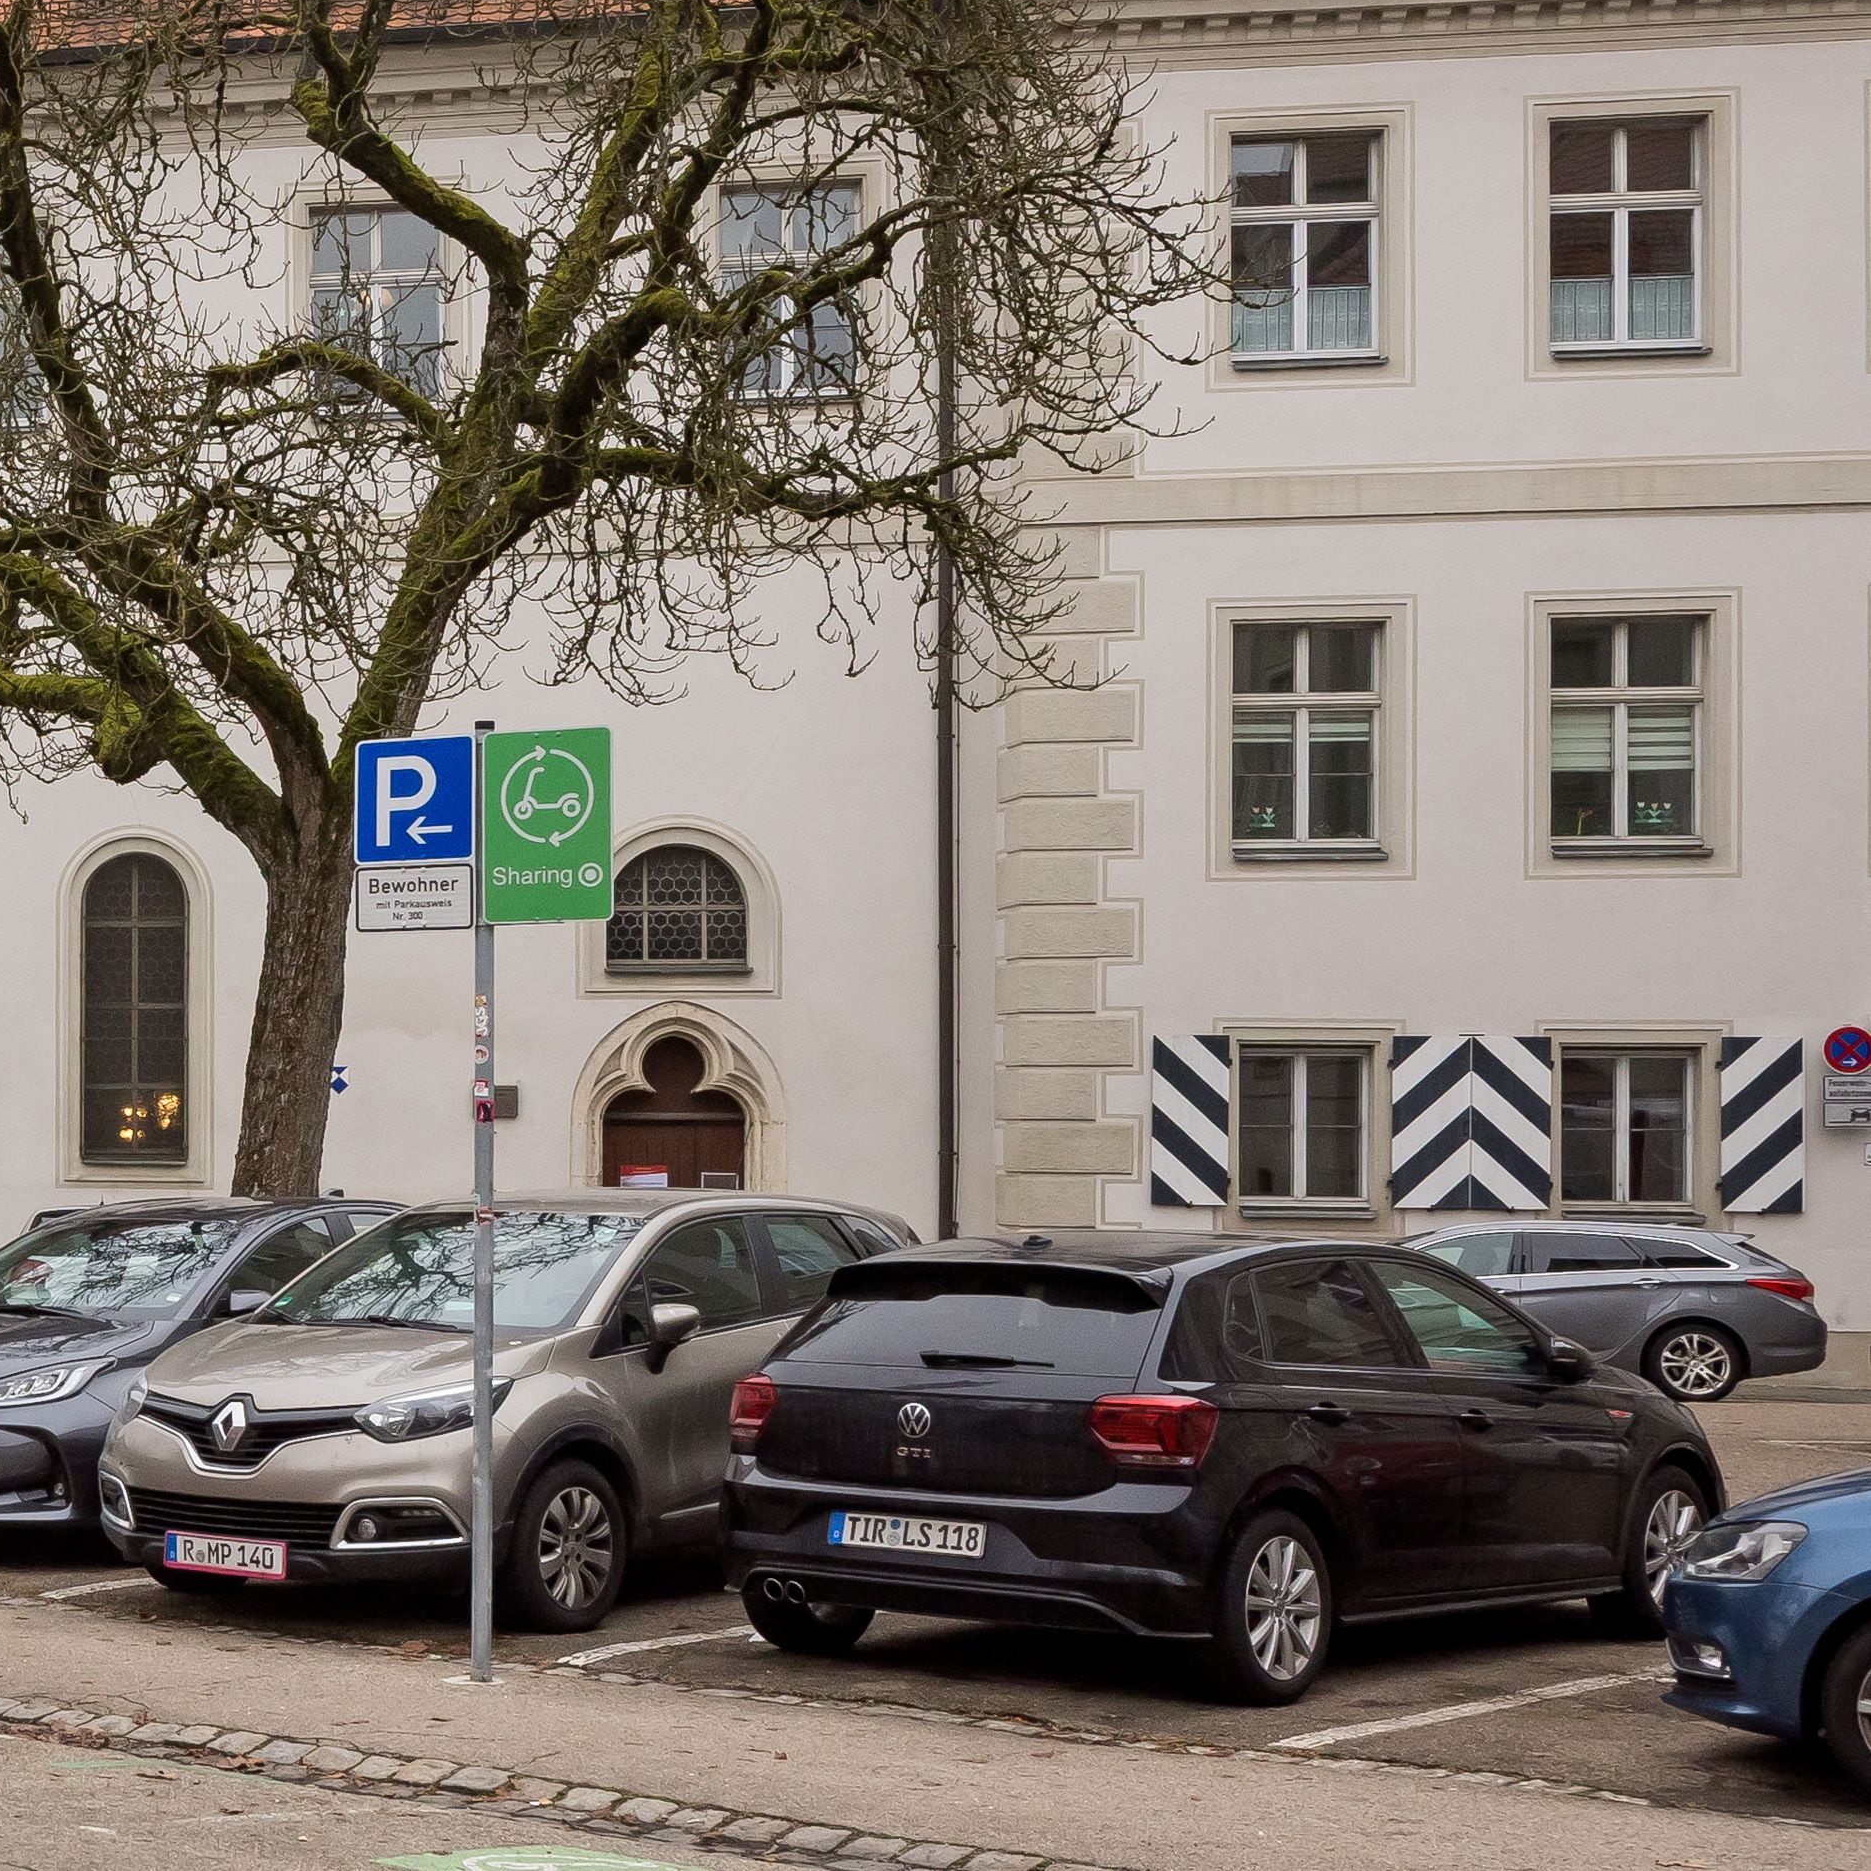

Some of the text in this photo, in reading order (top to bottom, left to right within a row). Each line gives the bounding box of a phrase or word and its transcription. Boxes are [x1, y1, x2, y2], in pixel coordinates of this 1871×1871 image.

[376, 755, 437, 847] P
[368, 876, 459, 895] Bewohner
[492, 865, 573, 889] Sharing
[376, 898, 452, 910] mit Parkausweis
[392, 911, 424, 921] Nr. 300
[896, 1446, 932, 1459] GTI
[847, 1516, 887, 1544] TIR
[902, 1519, 933, 1548] LS
[935, 1524, 980, 1552] 118
[182, 1539, 195, 1562] R
[207, 1541, 232, 1565] MP
[236, 1544, 274, 1570] 140
